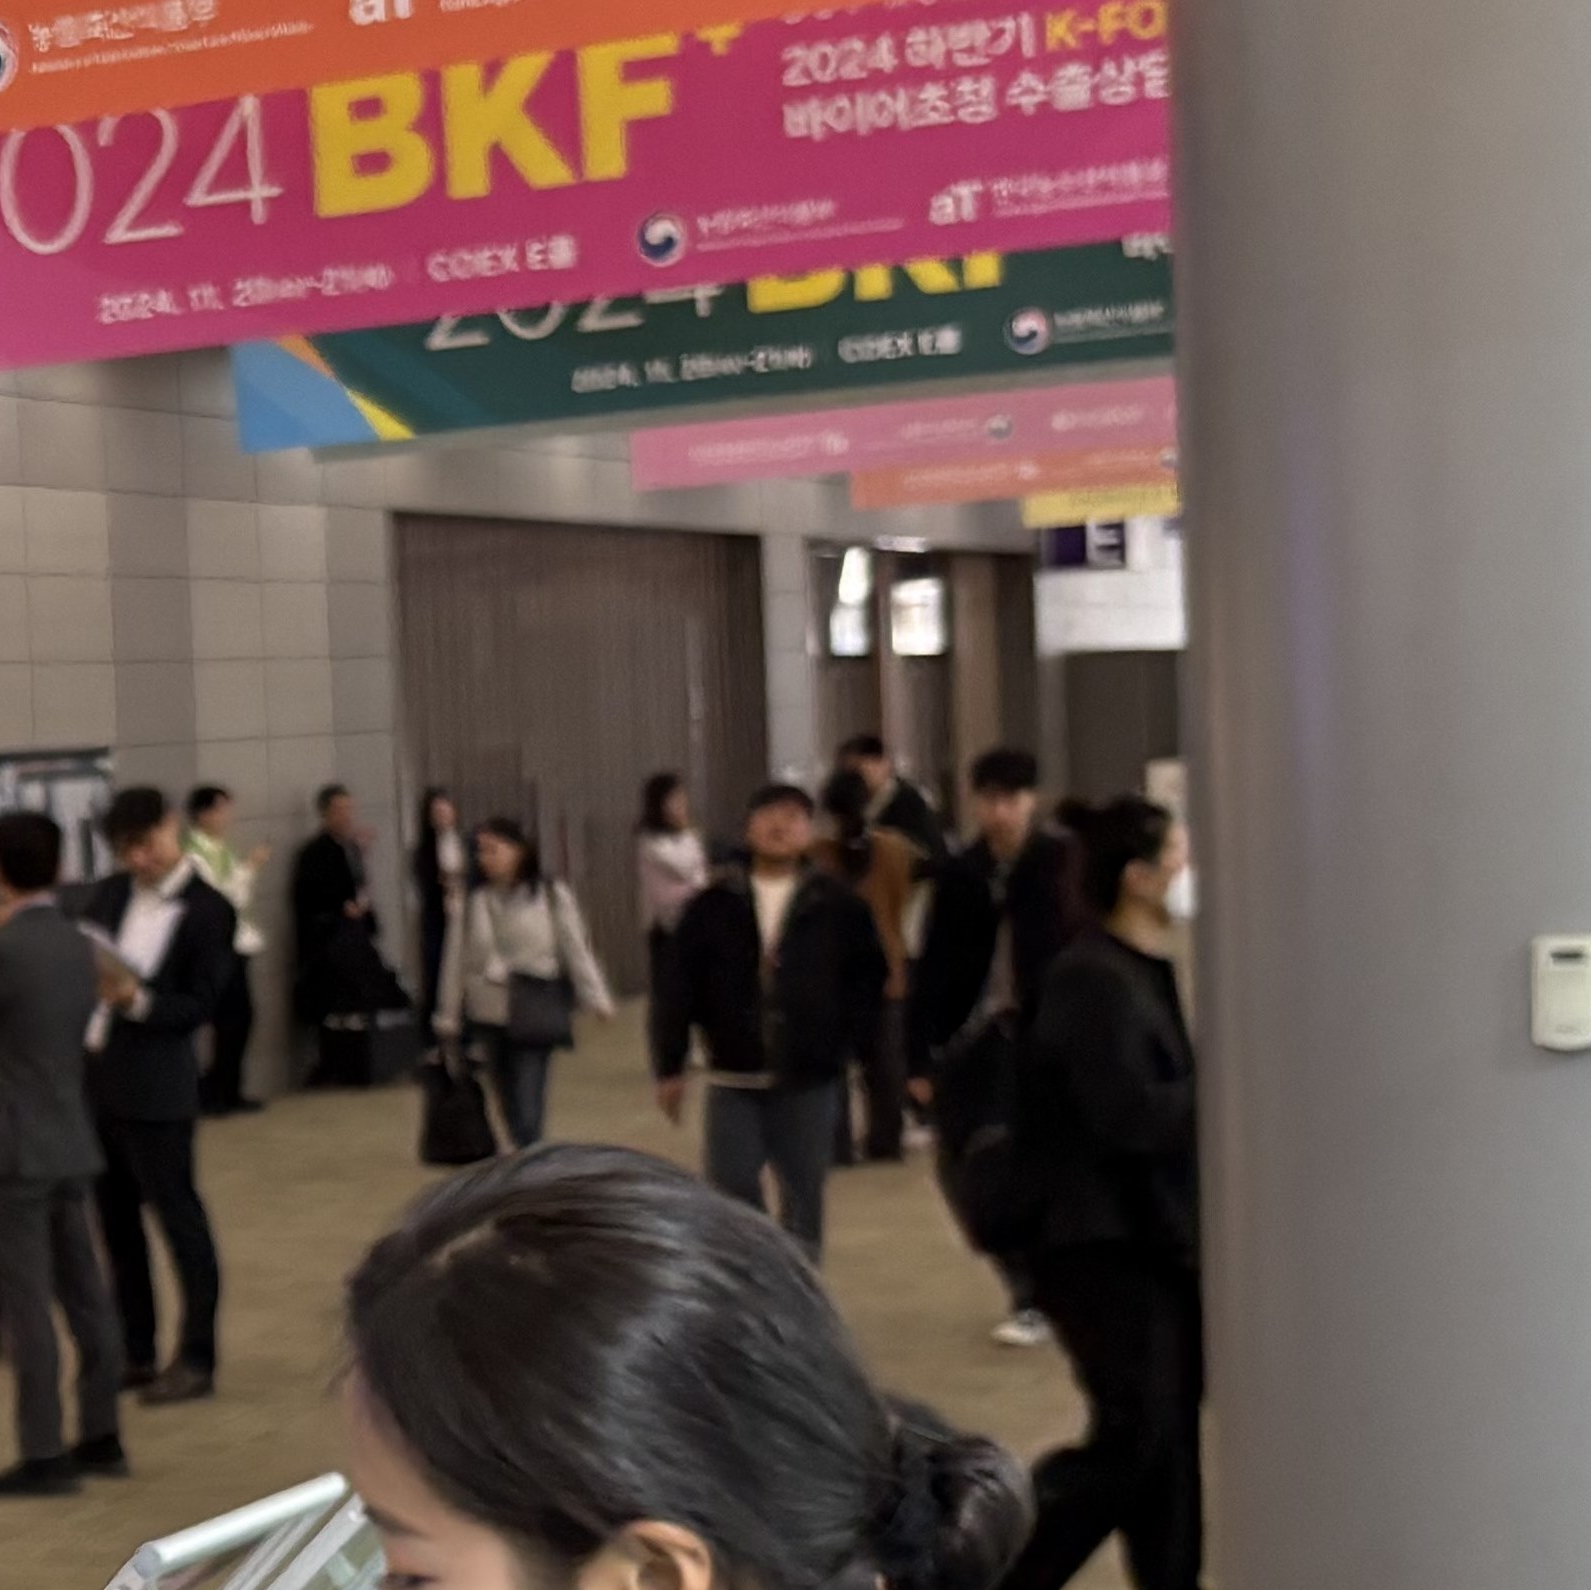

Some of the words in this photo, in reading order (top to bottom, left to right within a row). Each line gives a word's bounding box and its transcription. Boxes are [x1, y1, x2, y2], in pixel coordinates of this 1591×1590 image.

[781, 31, 899, 87] 2024
[903, 12, 1036, 71] 하반기
[782, 74, 999, 141] 바이어초청
